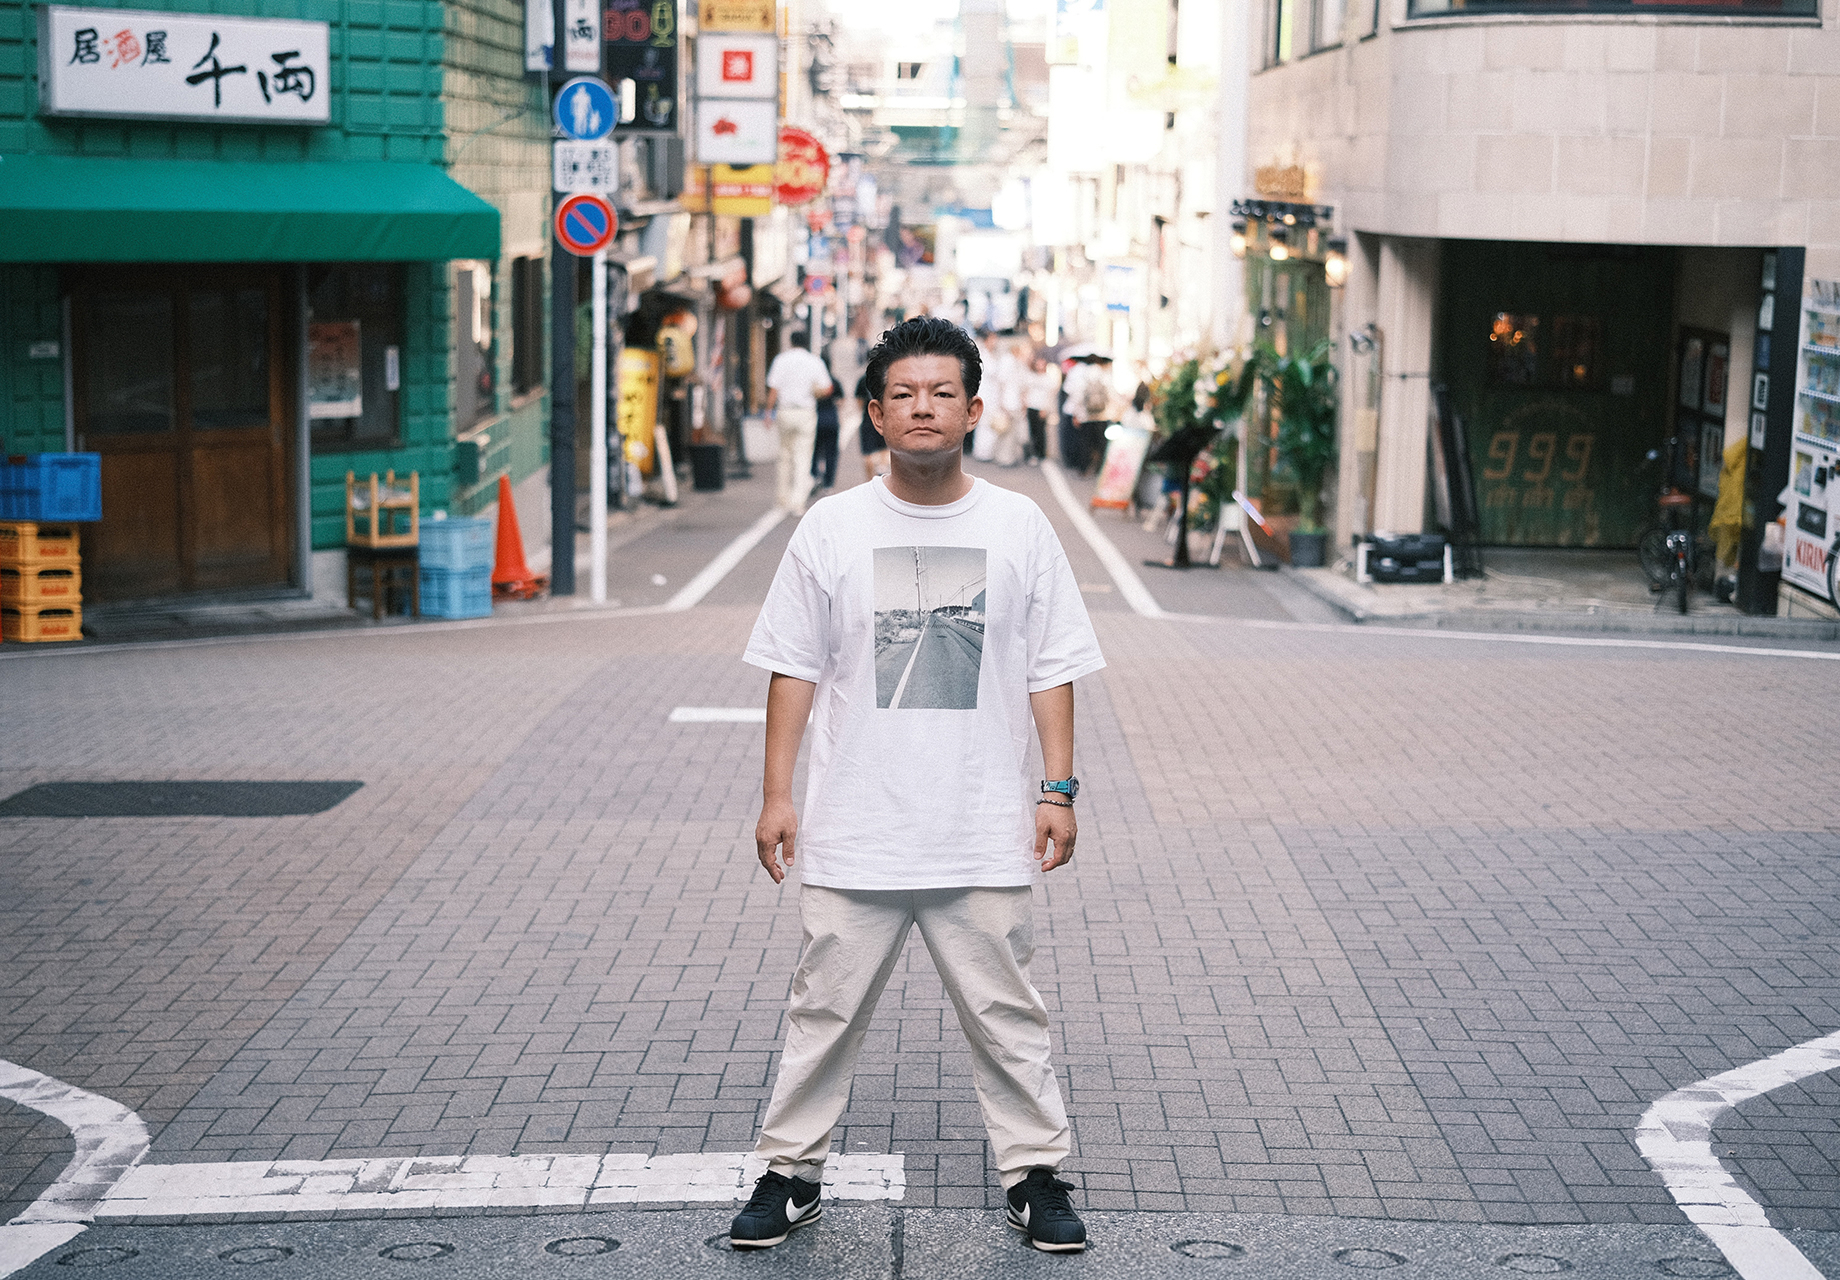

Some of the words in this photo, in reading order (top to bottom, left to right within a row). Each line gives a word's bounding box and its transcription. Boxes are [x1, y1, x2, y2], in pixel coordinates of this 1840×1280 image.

[69, 28, 171, 69] 居酒屋
[185, 31, 315, 108] 千両
[1483, 431, 1595, 482] 999
[1795, 538, 1828, 574] KIRIN
